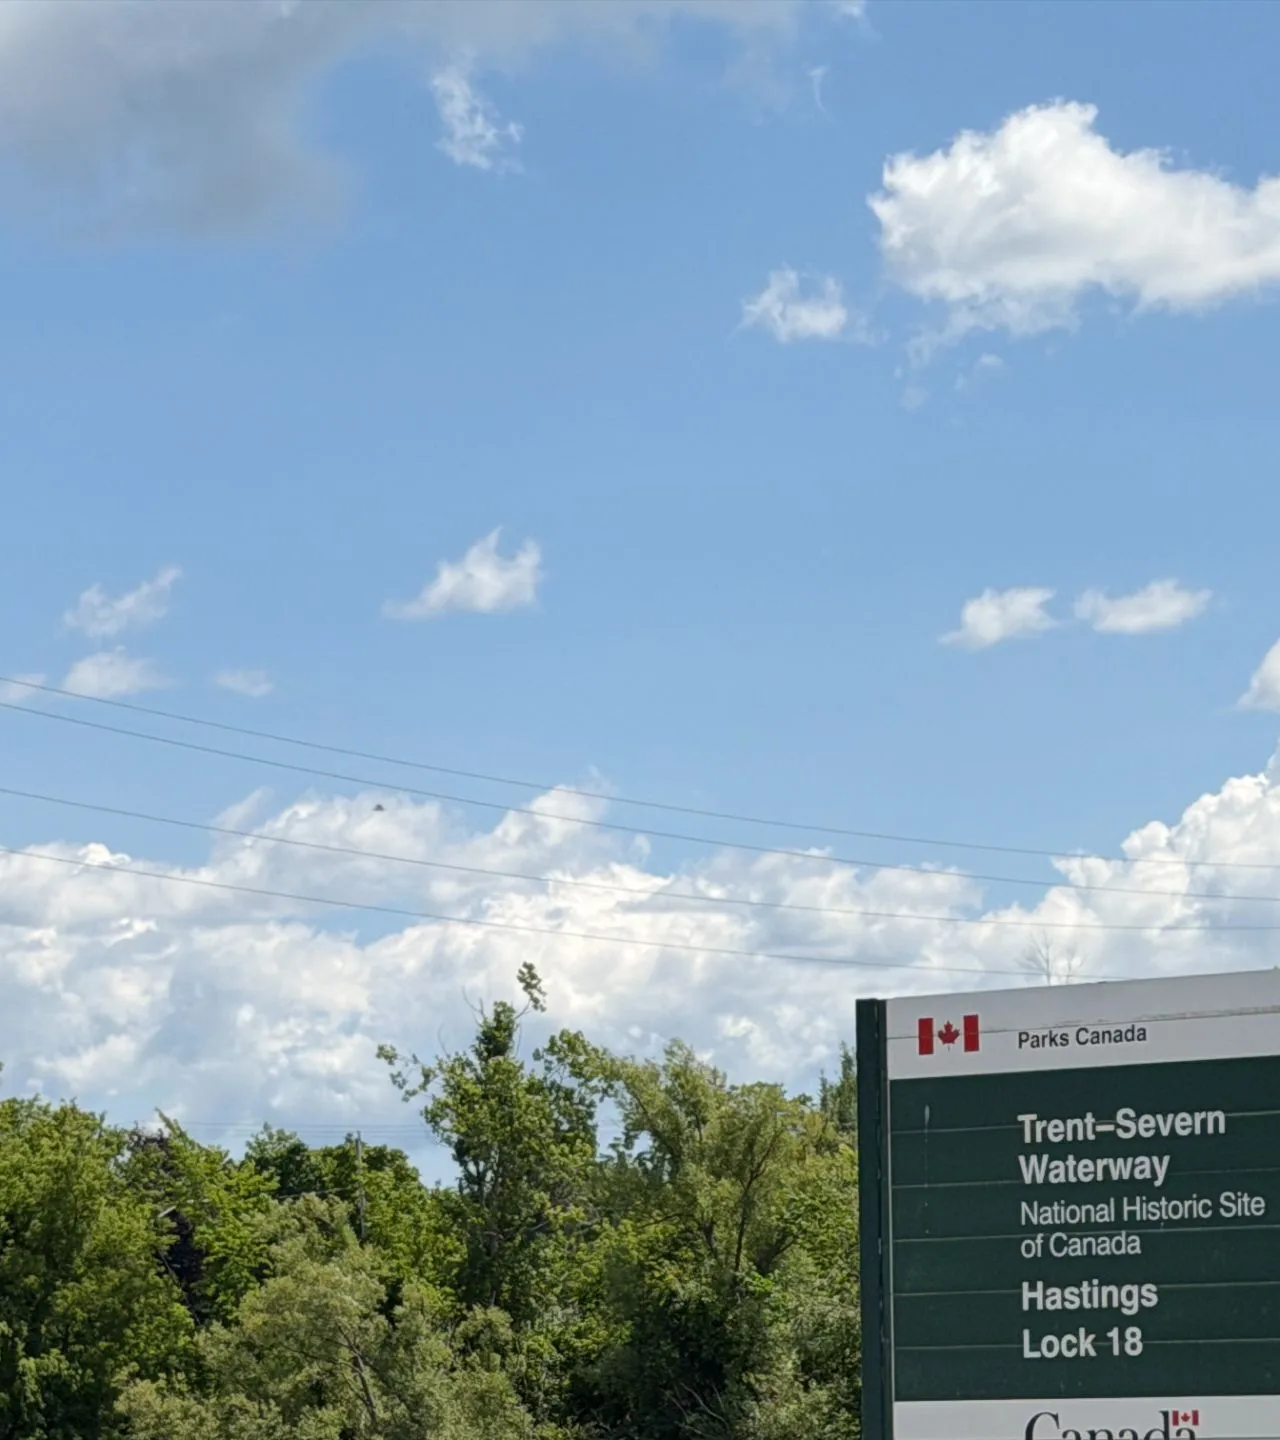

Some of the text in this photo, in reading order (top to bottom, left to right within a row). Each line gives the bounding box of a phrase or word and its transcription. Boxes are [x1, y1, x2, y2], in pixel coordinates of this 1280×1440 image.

[1018, 1024, 1147, 1049] Parks Canada
[1018, 1154, 1170, 1187] Waterway
[1021, 1192, 1266, 1225] National Historic Site
[1021, 1231, 1141, 1258] of Canada
[1022, 1279, 1158, 1315] Hastings
[1023, 1327, 1143, 1358] Lock 18
